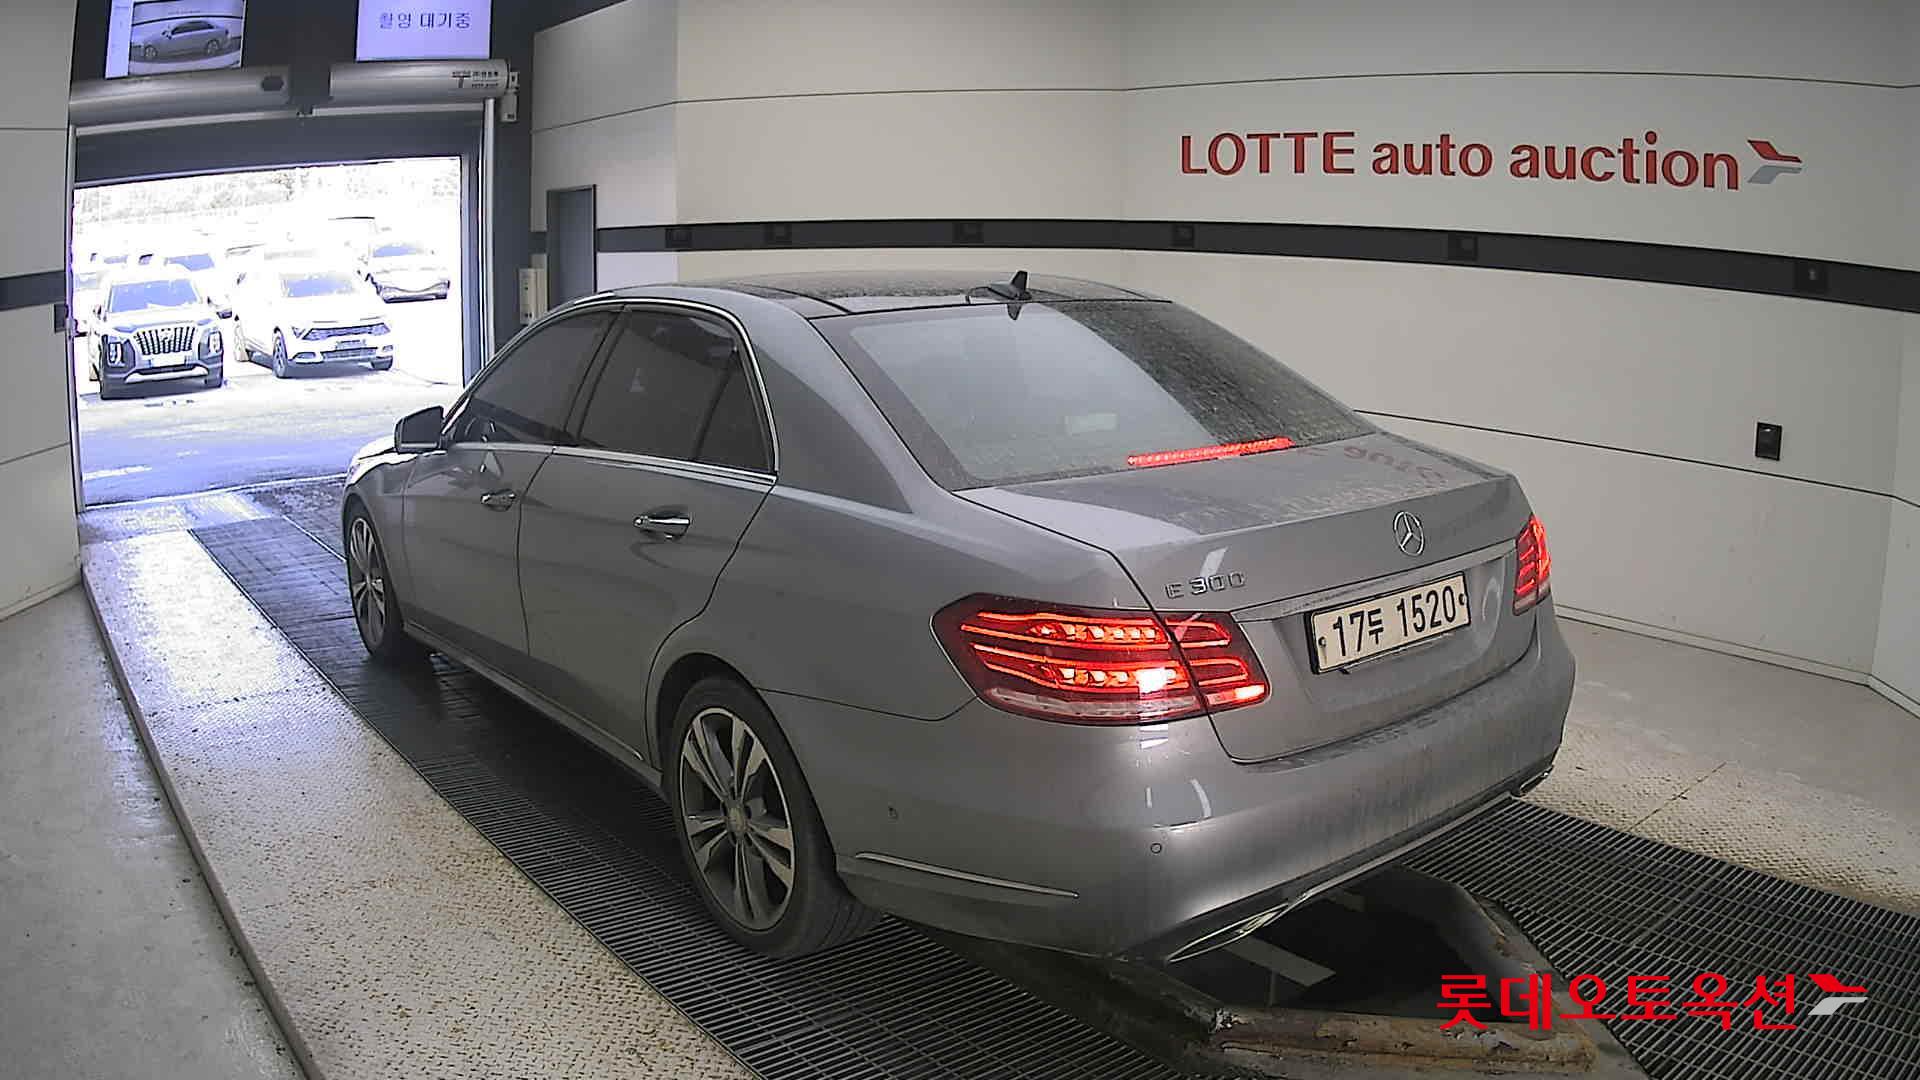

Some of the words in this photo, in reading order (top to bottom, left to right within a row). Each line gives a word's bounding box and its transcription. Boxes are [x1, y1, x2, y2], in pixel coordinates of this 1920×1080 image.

[420, 11, 472, 30] 대기중
[1181, 131, 1356, 176] LOTTE
[1372, 133, 1494, 178] auto
[1508, 130, 1740, 191] auction
[1165, 581, 1185, 600] E
[1188, 571, 1248, 597] 300
[1332, 606, 1385, 658] 17두
[1396, 585, 1458, 638] 1520
